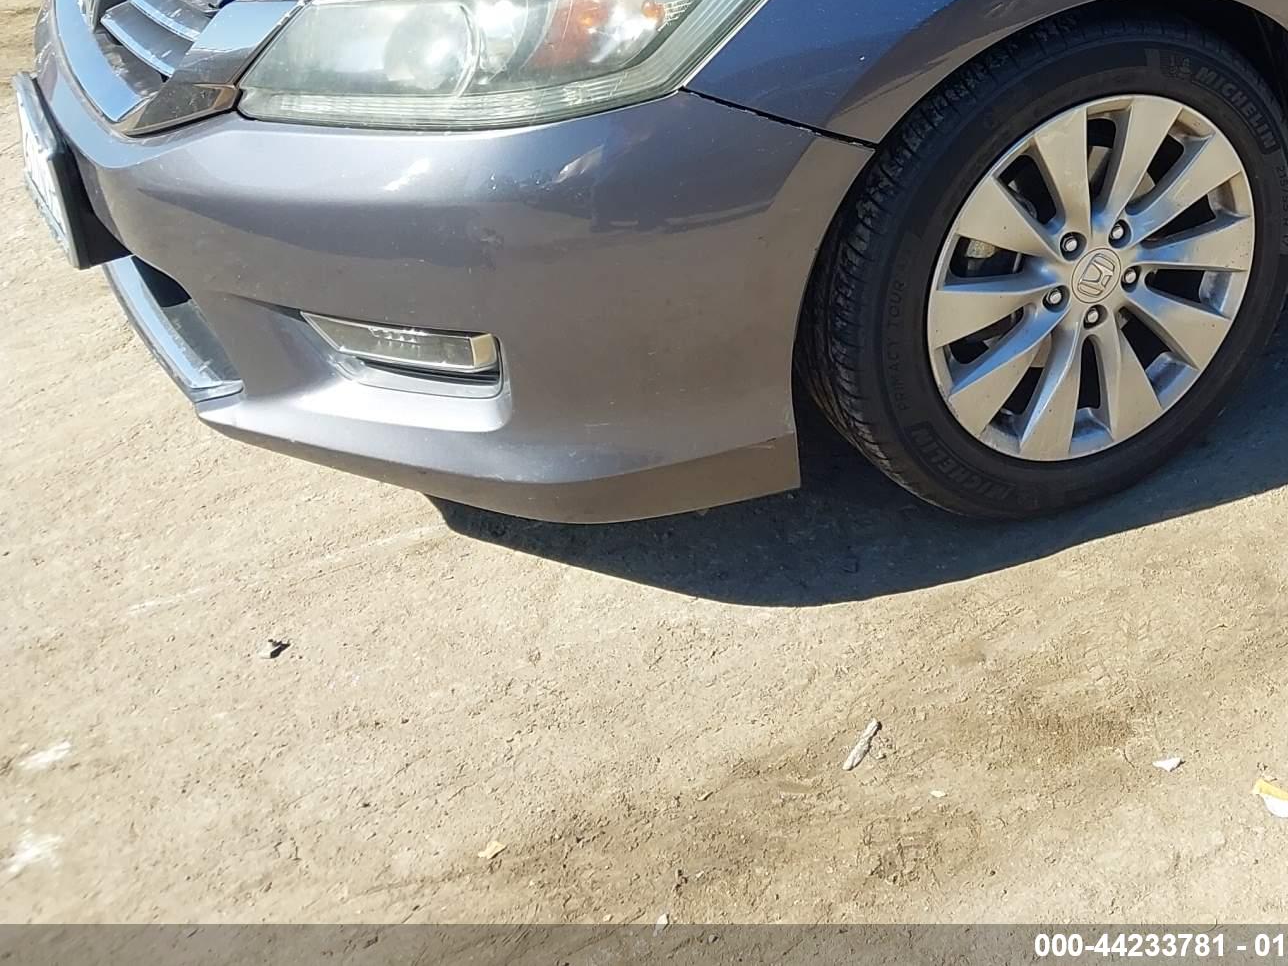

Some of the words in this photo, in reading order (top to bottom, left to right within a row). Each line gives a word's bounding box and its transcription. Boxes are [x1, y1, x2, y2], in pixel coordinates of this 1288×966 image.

[1195, 65, 1279, 151] MICHELIN
[888, 279, 905, 328] TOUR
[910, 425, 1011, 502] MICHELIN
